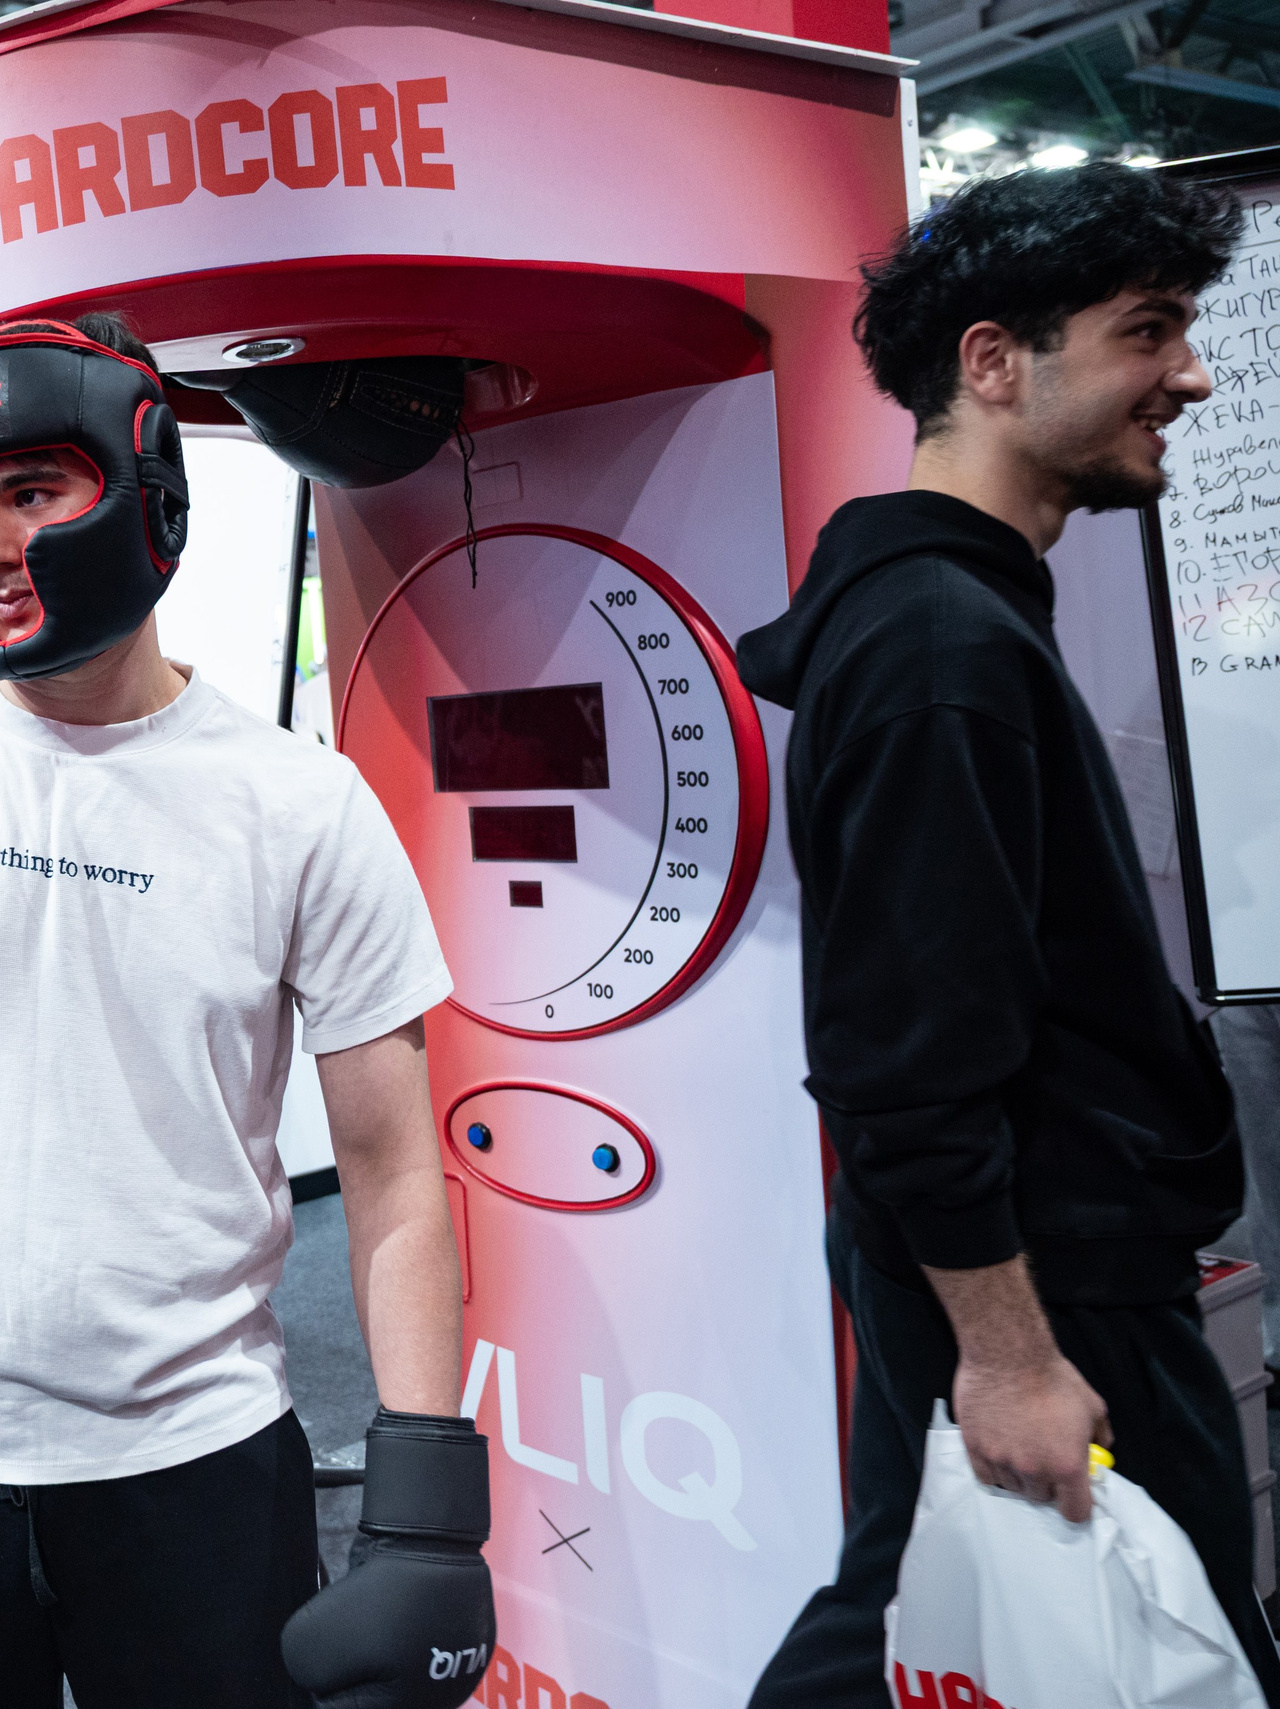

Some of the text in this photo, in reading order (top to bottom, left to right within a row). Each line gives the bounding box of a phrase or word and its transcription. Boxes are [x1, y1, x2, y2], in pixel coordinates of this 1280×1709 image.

[605, 589, 637, 608] 900
[637, 632, 670, 651] 800
[657, 677, 690, 695] 700
[671, 724, 704, 742] 600
[676, 771, 710, 788] 500
[674, 817, 708, 834] 400
[58, 856, 78, 877] to
[84, 864, 155, 894] worry
[666, 862, 699, 879] 300
[649, 906, 681, 923] 200
[623, 948, 654, 965] 200
[586, 983, 614, 999] 100
[544, 1004, 555, 1019] 0
